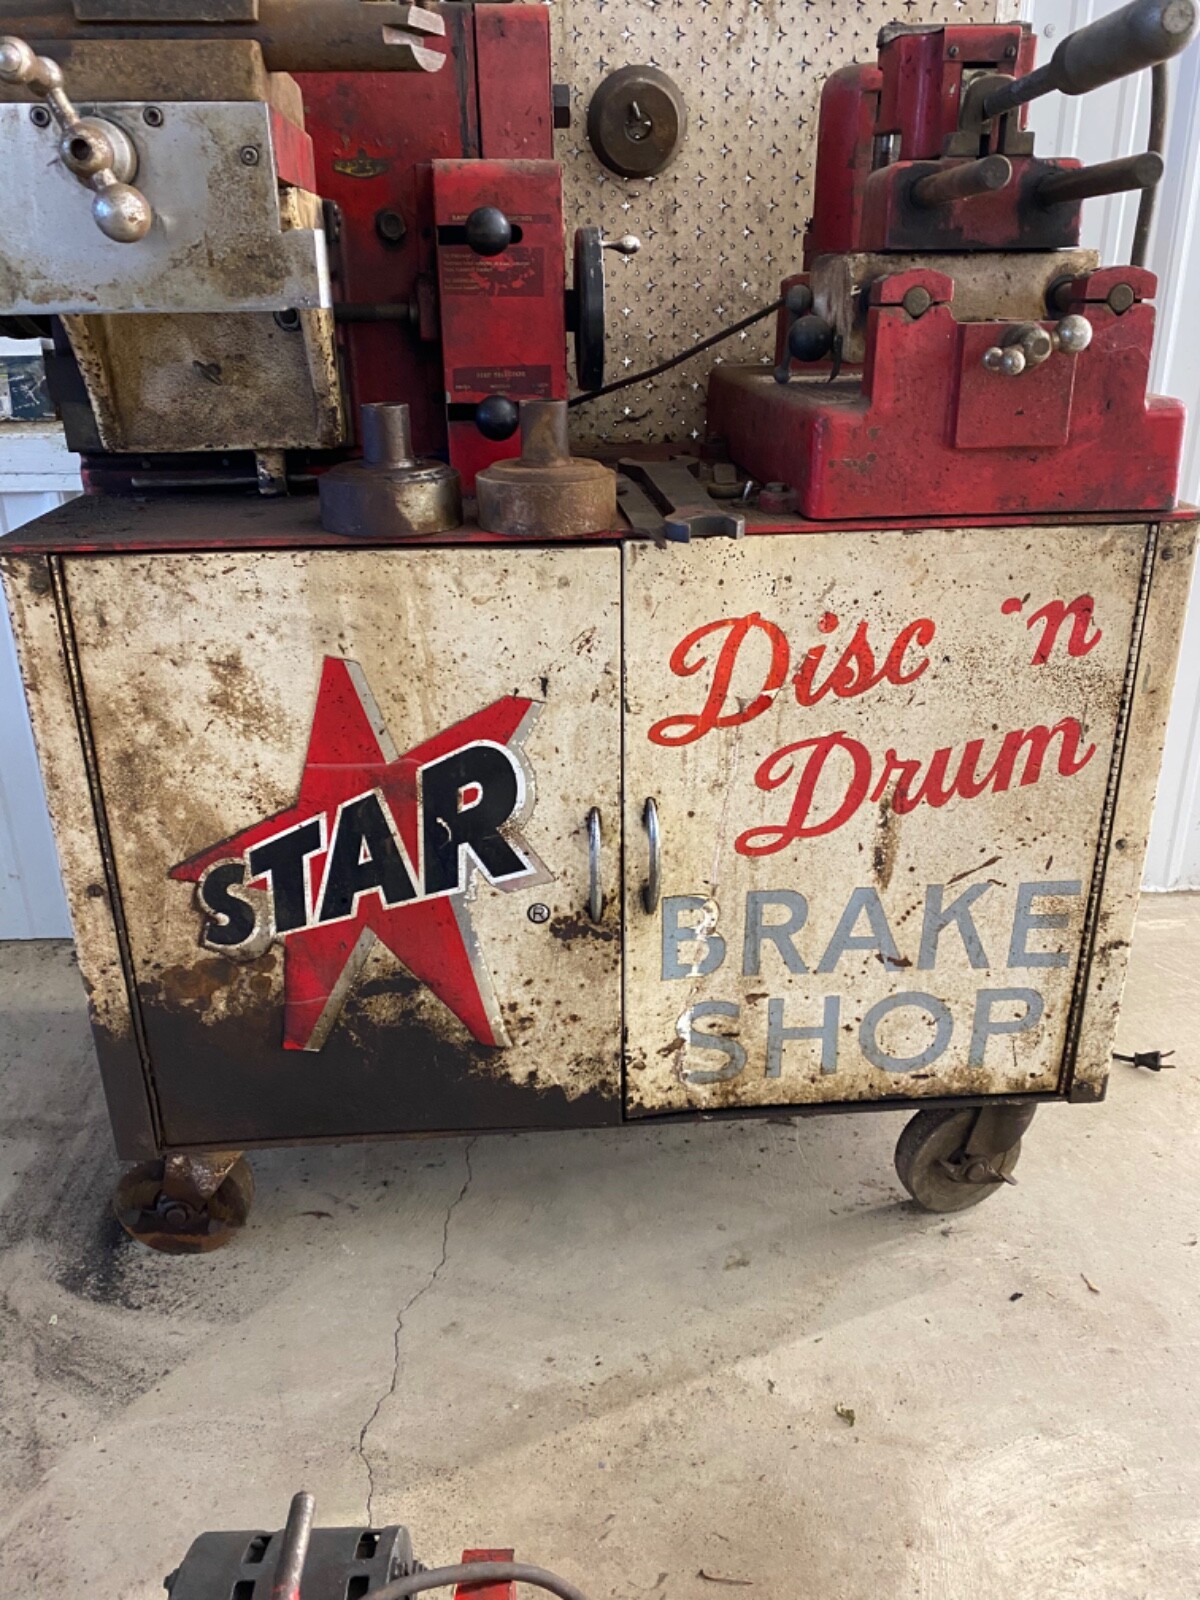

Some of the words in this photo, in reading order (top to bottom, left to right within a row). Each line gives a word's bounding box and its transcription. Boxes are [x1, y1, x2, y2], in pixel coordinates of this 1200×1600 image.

[646, 612, 936, 747] Disc
[198, 738, 537, 949] STAR
[734, 716, 1097, 857] Drum
[660, 879, 1083, 981] BRAKE
[678, 987, 1045, 1084] SHOP
